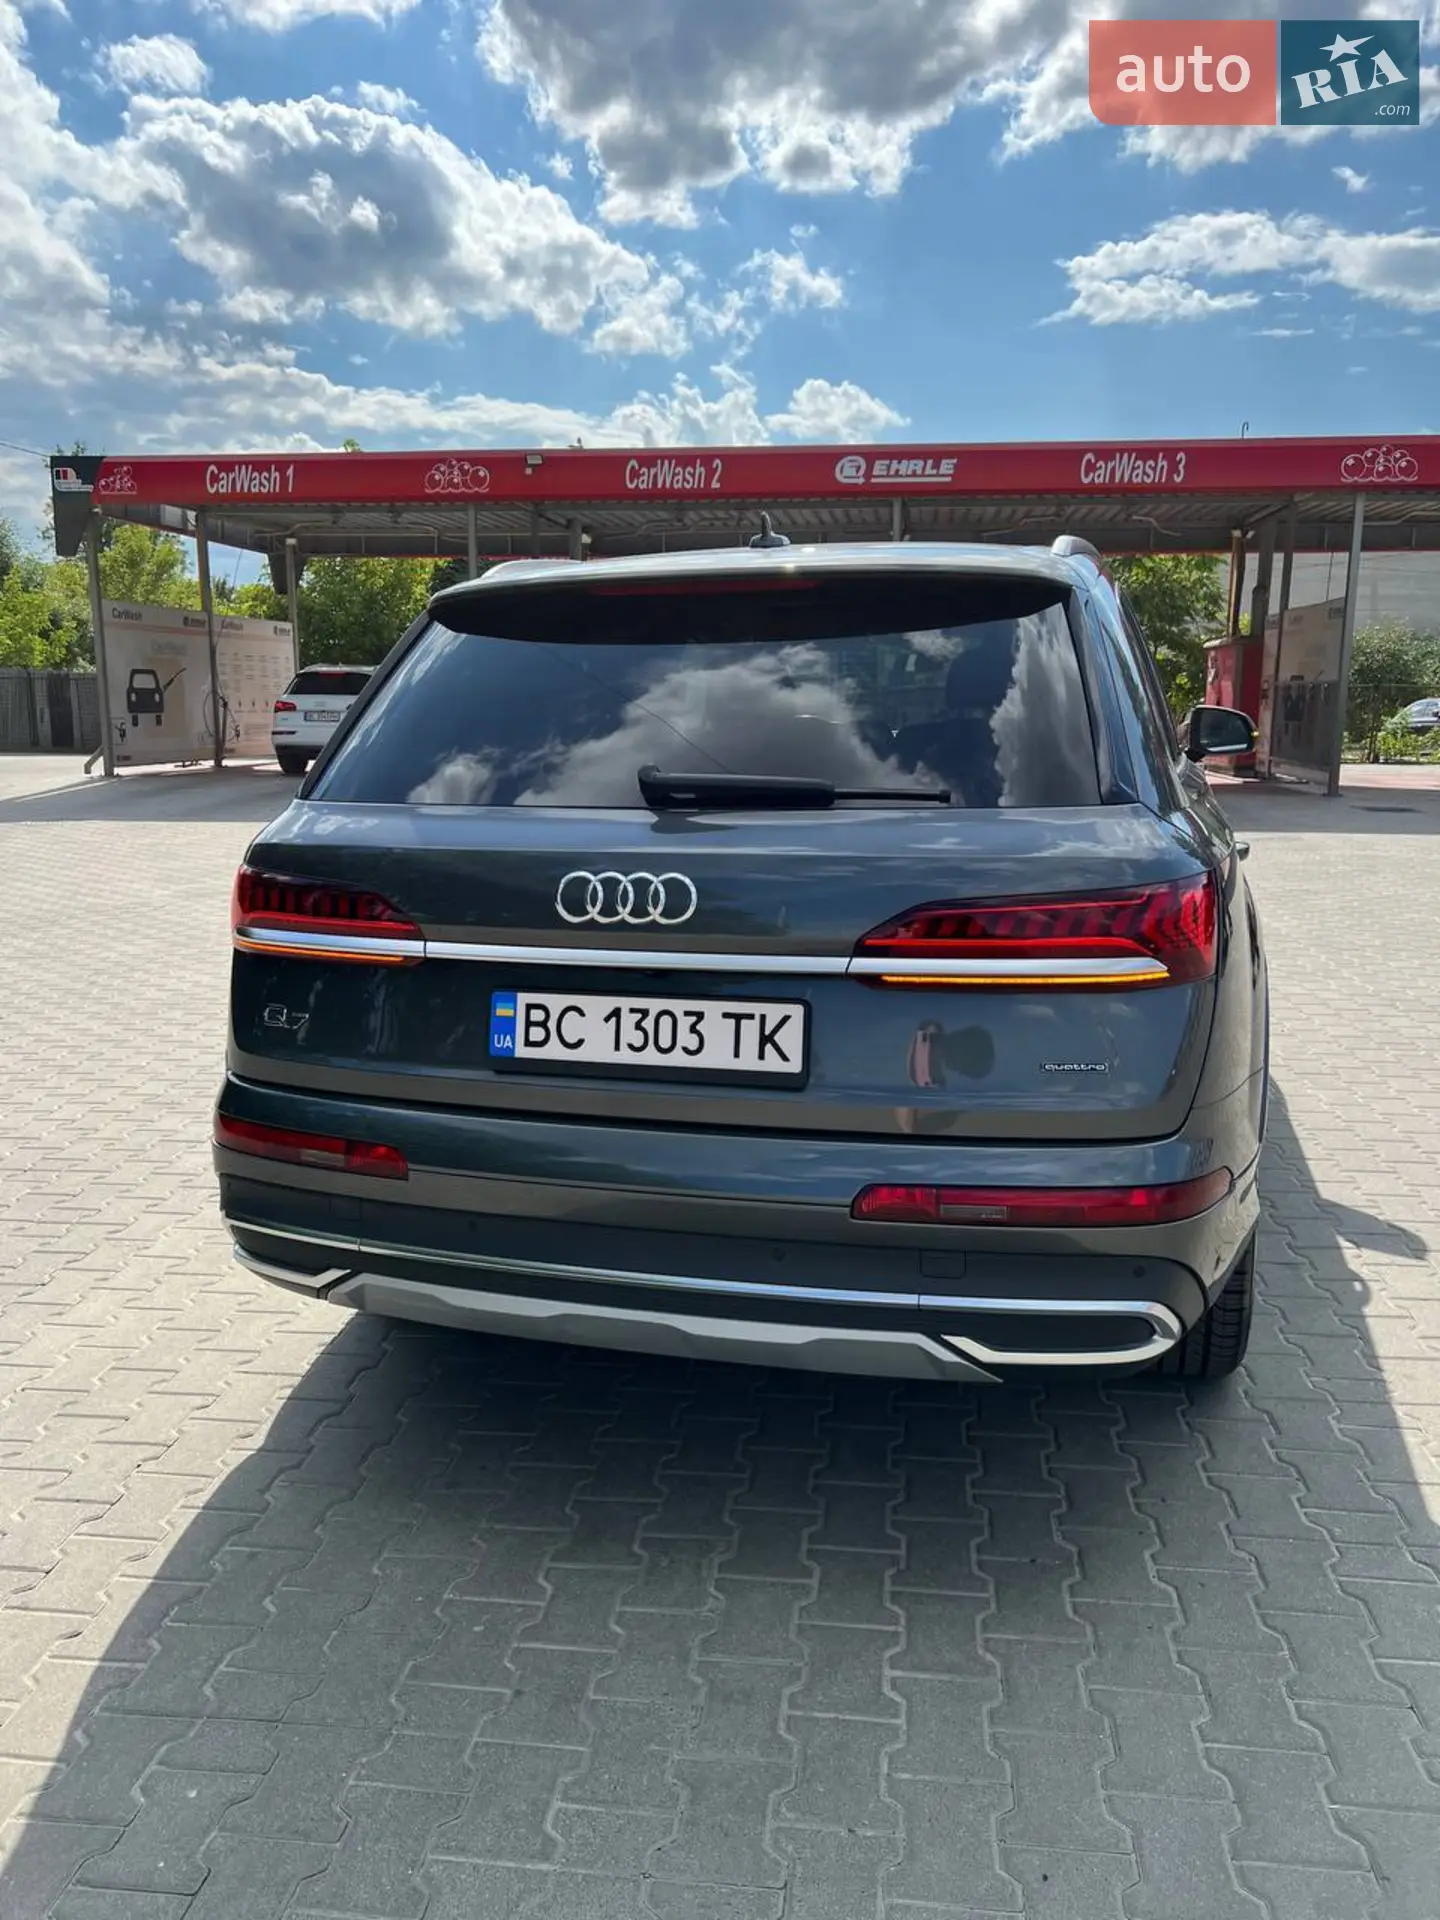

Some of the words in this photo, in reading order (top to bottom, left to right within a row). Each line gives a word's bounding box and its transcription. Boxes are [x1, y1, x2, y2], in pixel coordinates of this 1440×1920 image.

[205, 463, 281, 495] CarWash
[286, 463, 295, 493] 1
[625, 459, 706, 491] CarWash
[711, 459, 723, 489] 2
[872, 458, 958, 476] EHRLE
[1080, 451, 1168, 484] CarWash
[1173, 451, 1186, 484] 3
[263, 1002, 310, 1030] Q7
[494, 1034, 513, 1049] UA
[523, 1002, 587, 1050] BC
[602, 1006, 706, 1057] 1303
[721, 1011, 792, 1063] TK
[1045, 1063, 1105, 1072] quattro
